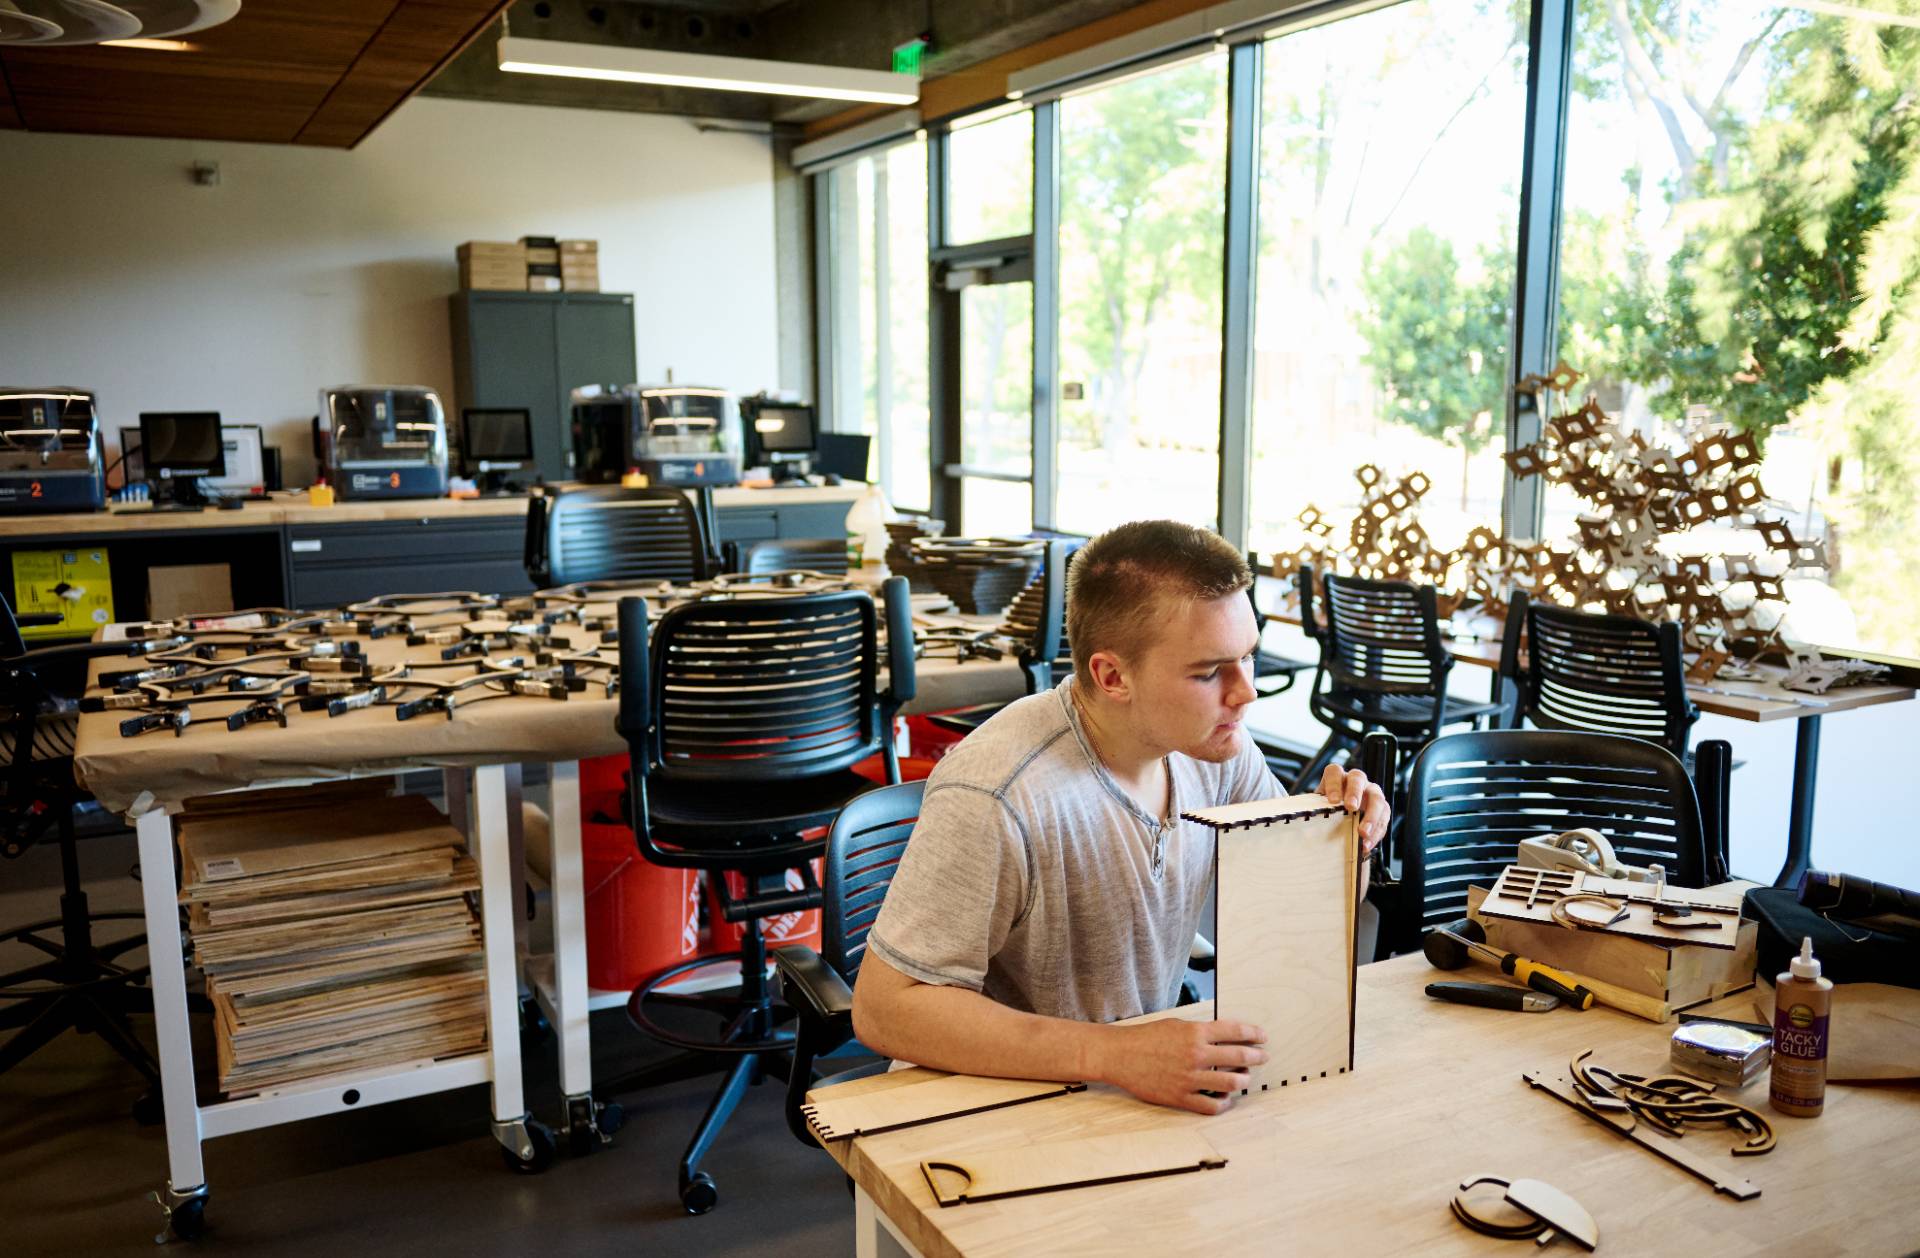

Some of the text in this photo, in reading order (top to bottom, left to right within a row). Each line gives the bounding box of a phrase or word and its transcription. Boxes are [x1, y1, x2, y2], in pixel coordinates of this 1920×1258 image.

[31, 480, 43, 498] 2
[1779, 1028, 1822, 1047] TACKY
[1780, 1041, 1816, 1057] GLUE
